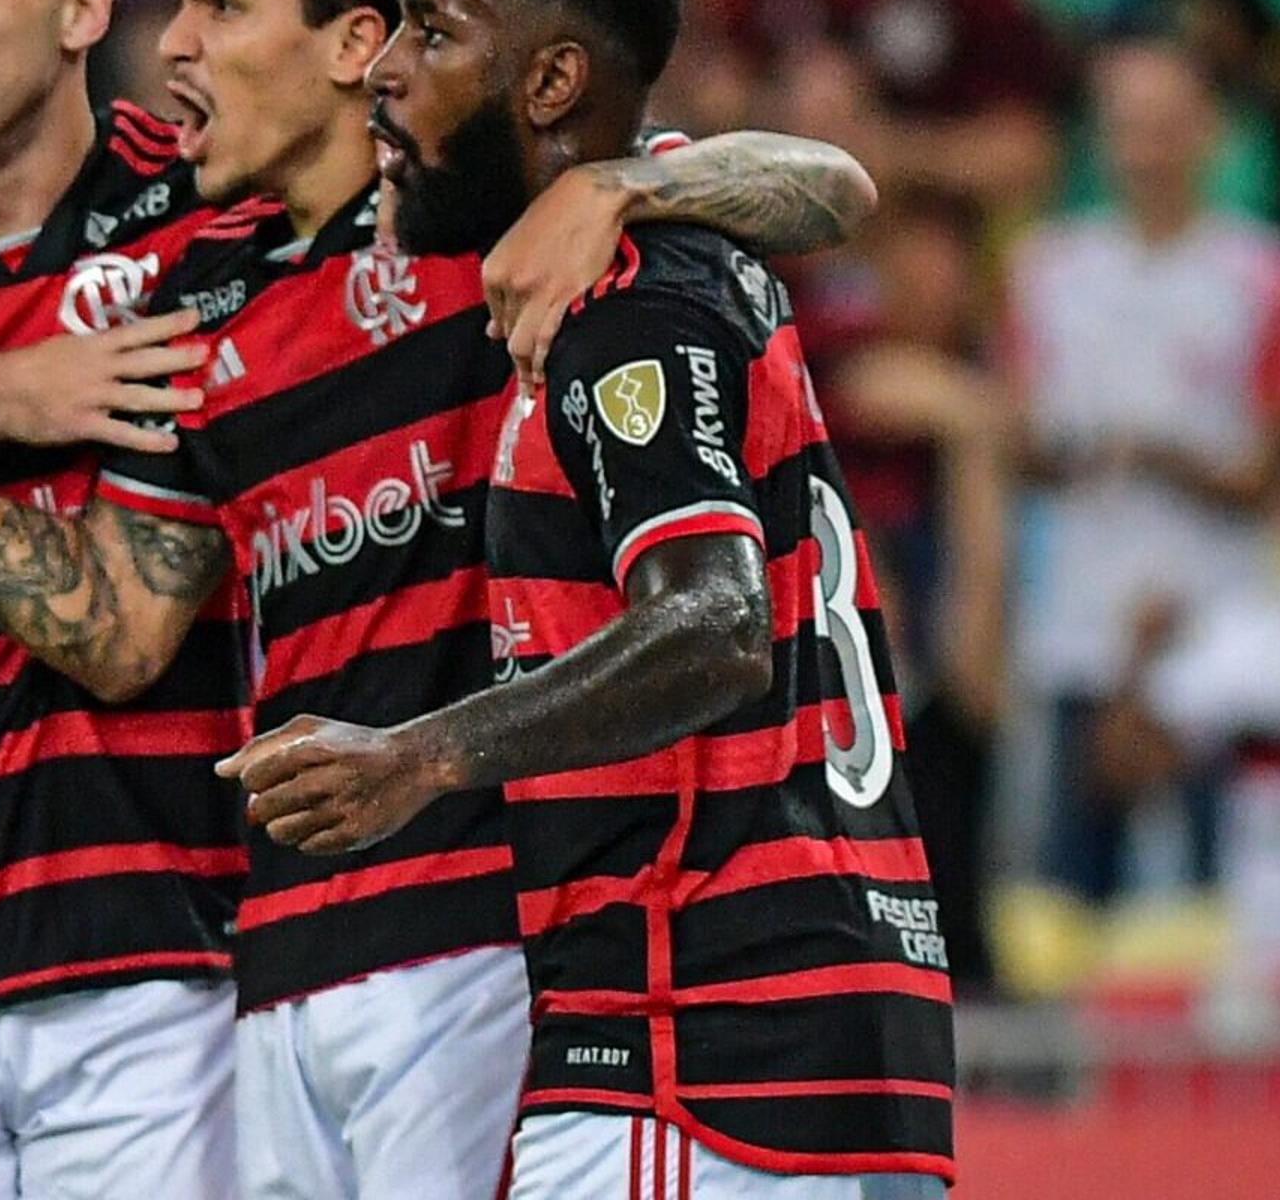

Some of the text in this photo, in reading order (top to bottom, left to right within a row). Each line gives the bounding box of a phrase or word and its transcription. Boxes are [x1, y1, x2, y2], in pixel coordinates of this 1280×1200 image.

[123, 182, 170, 220] RB
[251, 440, 466, 626] pixbet
[566, 1046, 630, 1066] HEAT.RDY
